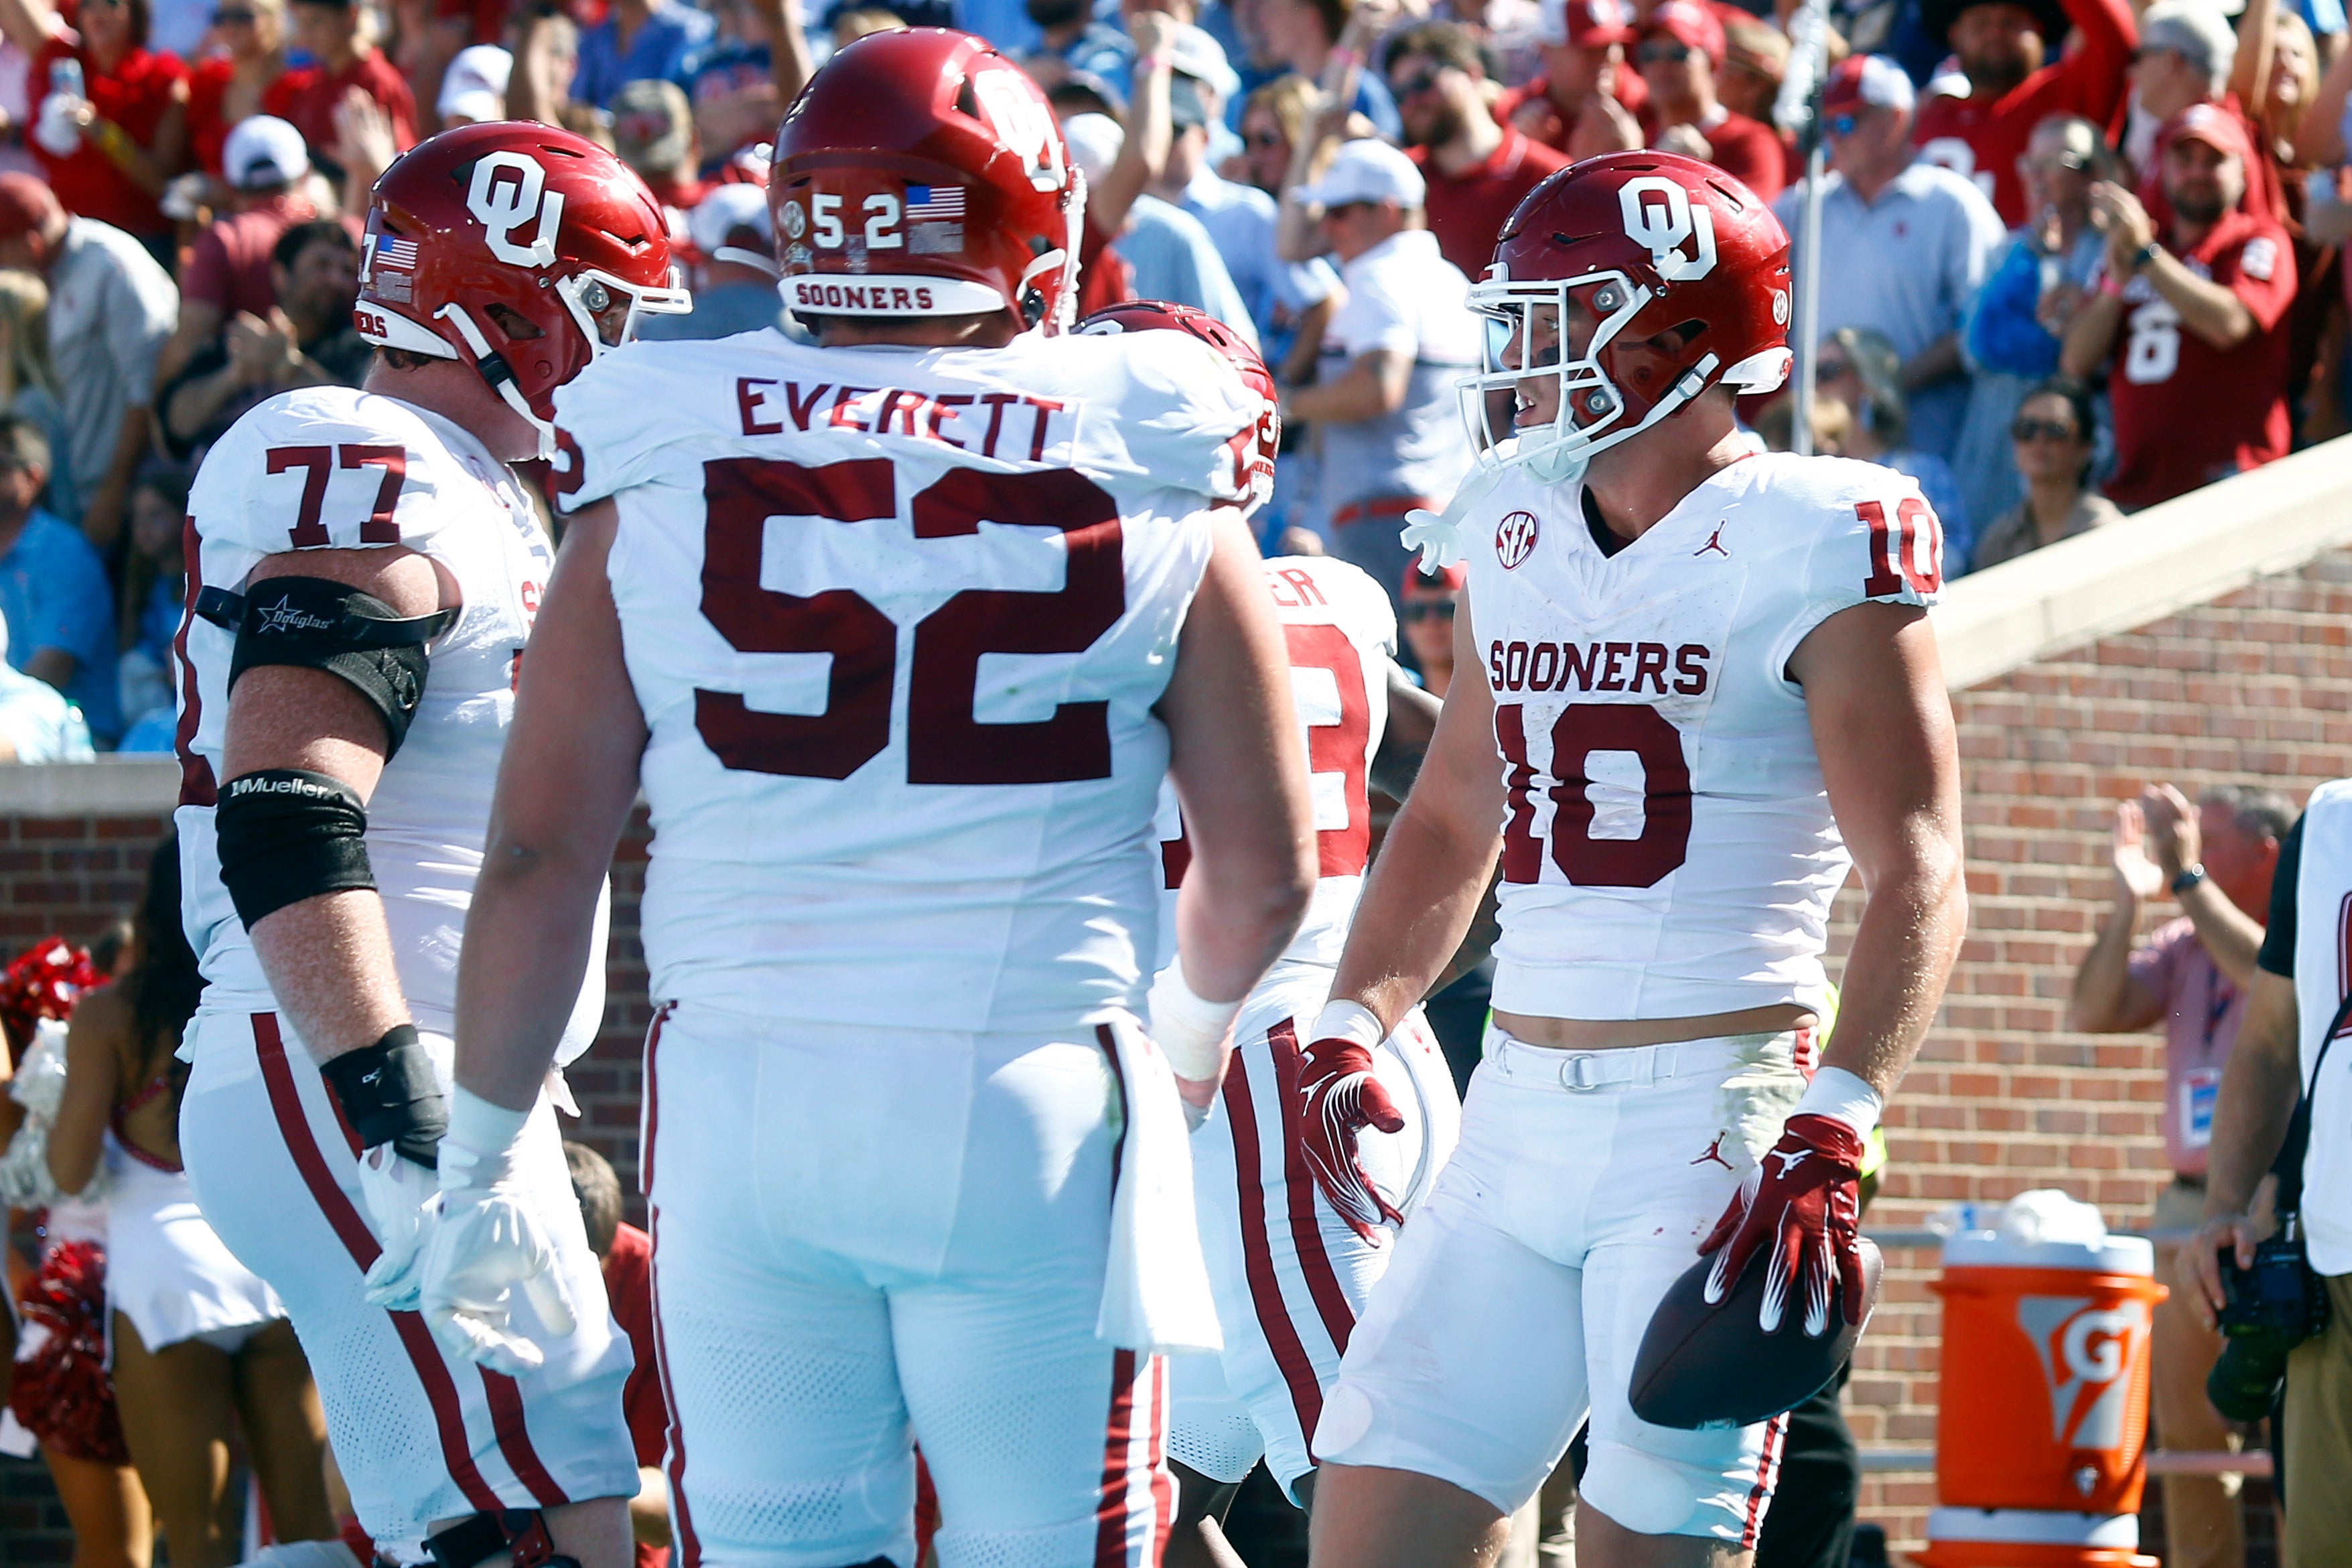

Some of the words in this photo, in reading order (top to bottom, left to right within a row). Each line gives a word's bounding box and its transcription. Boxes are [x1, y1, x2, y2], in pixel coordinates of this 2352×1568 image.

[467, 151, 565, 268] OU
[811, 193, 903, 249] 52
[1618, 176, 1717, 281] OU
[795, 283, 932, 309] SOONERS
[737, 377, 1064, 462] EVERETT
[266, 444, 406, 547] 77
[1498, 512, 1535, 567] SEC
[1855, 497, 1943, 598] 10
[271, 610, 328, 630] Douglas
[694, 457, 1126, 785] 52
[1491, 640, 1711, 696] SOONERS
[1494, 703, 1692, 888] 10
[2063, 1311, 2129, 1383] G
